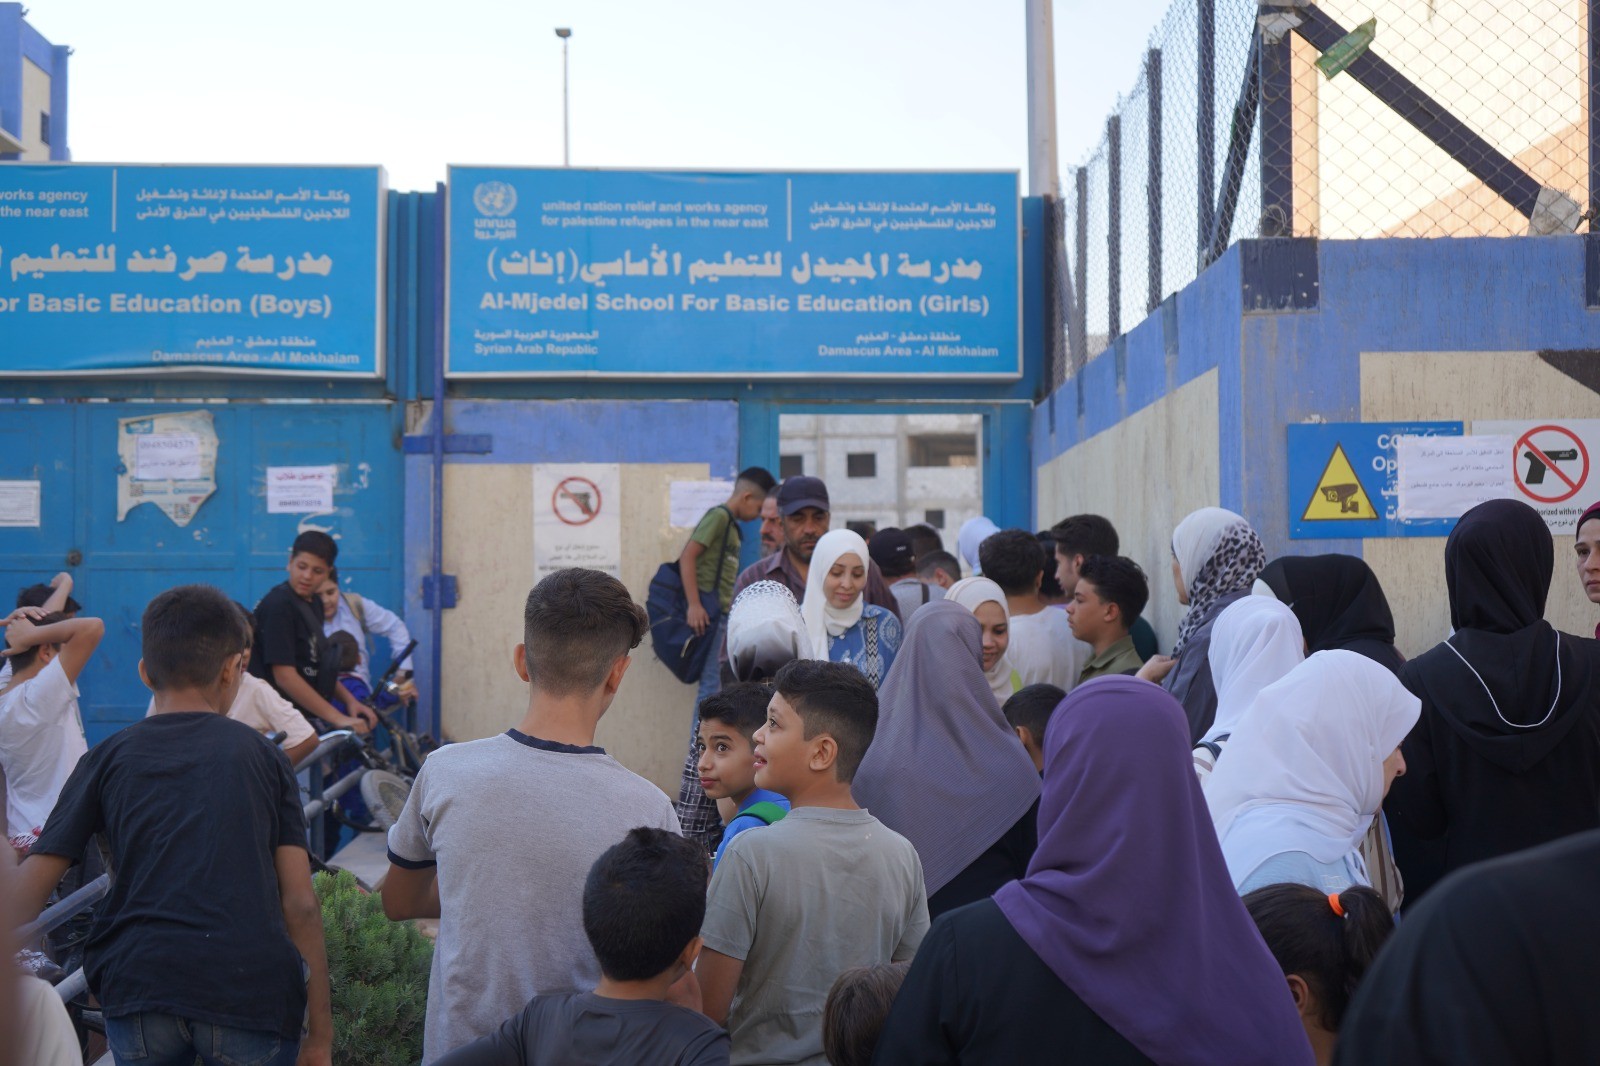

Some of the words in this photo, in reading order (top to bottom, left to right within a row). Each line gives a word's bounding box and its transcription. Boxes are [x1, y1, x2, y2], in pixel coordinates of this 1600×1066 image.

[38, 191, 89, 204] agency
[230, 189, 273, 201] المتحدة
[0, 205, 22, 218] the
[25, 207, 57, 218] near
[59, 206, 89, 218] east
[173, 207, 207, 220] الشرق
[541, 200, 582, 212] united
[584, 201, 622, 212] nation
[625, 201, 656, 212] relief
[658, 202, 682, 213] and
[685, 202, 721, 214] works
[724, 203, 768, 216] agency
[891, 202, 928, 212] المتحدة
[209, 208, 226, 223] في
[228, 207, 301, 221] الفلسطينيين
[474, 218, 517, 229] unrwa
[541, 215, 560, 226] for
[562, 215, 617, 229] palestine
[620, 216, 673, 230] refugees
[676, 216, 688, 227] in
[690, 216, 710, 227] the
[713, 217, 740, 228] near
[743, 217, 768, 228] east
[842, 217, 871, 230] الشرق
[873, 218, 888, 232] في
[890, 217, 954, 231] الفلسطينيين
[10, 243, 116, 282] للتعليم
[127, 245, 228, 282] صرفند
[236, 246, 333, 281] مدرسة
[688, 251, 782, 285] للتعليم
[791, 250, 890, 286] المجيدل
[897, 252, 982, 284] مدرسة
[0, 297, 20, 313] or
[28, 293, 101, 313] Basic
[110, 294, 241, 314] Education
[250, 293, 333, 319] (Boys)
[480, 292, 588, 315] Al-Mjedel
[596, 293, 674, 312] School
[682, 294, 720, 312] For
[726, 294, 790, 312] Basic
[797, 294, 912, 313] Education
[919, 294, 989, 317] (Girls)
[281, 336, 317, 347] منطقة
[474, 329, 512, 341] السورية
[513, 330, 547, 342] العربية
[549, 330, 599, 342] الجمهورية
[856, 331, 889, 344] المخيم
[898, 332, 928, 343] دمشق
[930, 332, 961, 342] منطقة
[195, 336, 235, 350] المخيم
[244, 336, 279, 349] دمشق
[474, 343, 513, 356] Syrian
[514, 343, 543, 354] Arab
[546, 343, 598, 356] Republic
[818, 345, 881, 356] Damascus
[883, 345, 912, 356] Area
[922, 345, 935, 356] Al
[938, 346, 999, 357] Mokhaiam
[152, 350, 223, 363] Damascus
[226, 351, 260, 363] Area
[270, 352, 286, 363] Al
[289, 352, 359, 364] Mokhaiam
[1559, 507, 1577, 515] within
